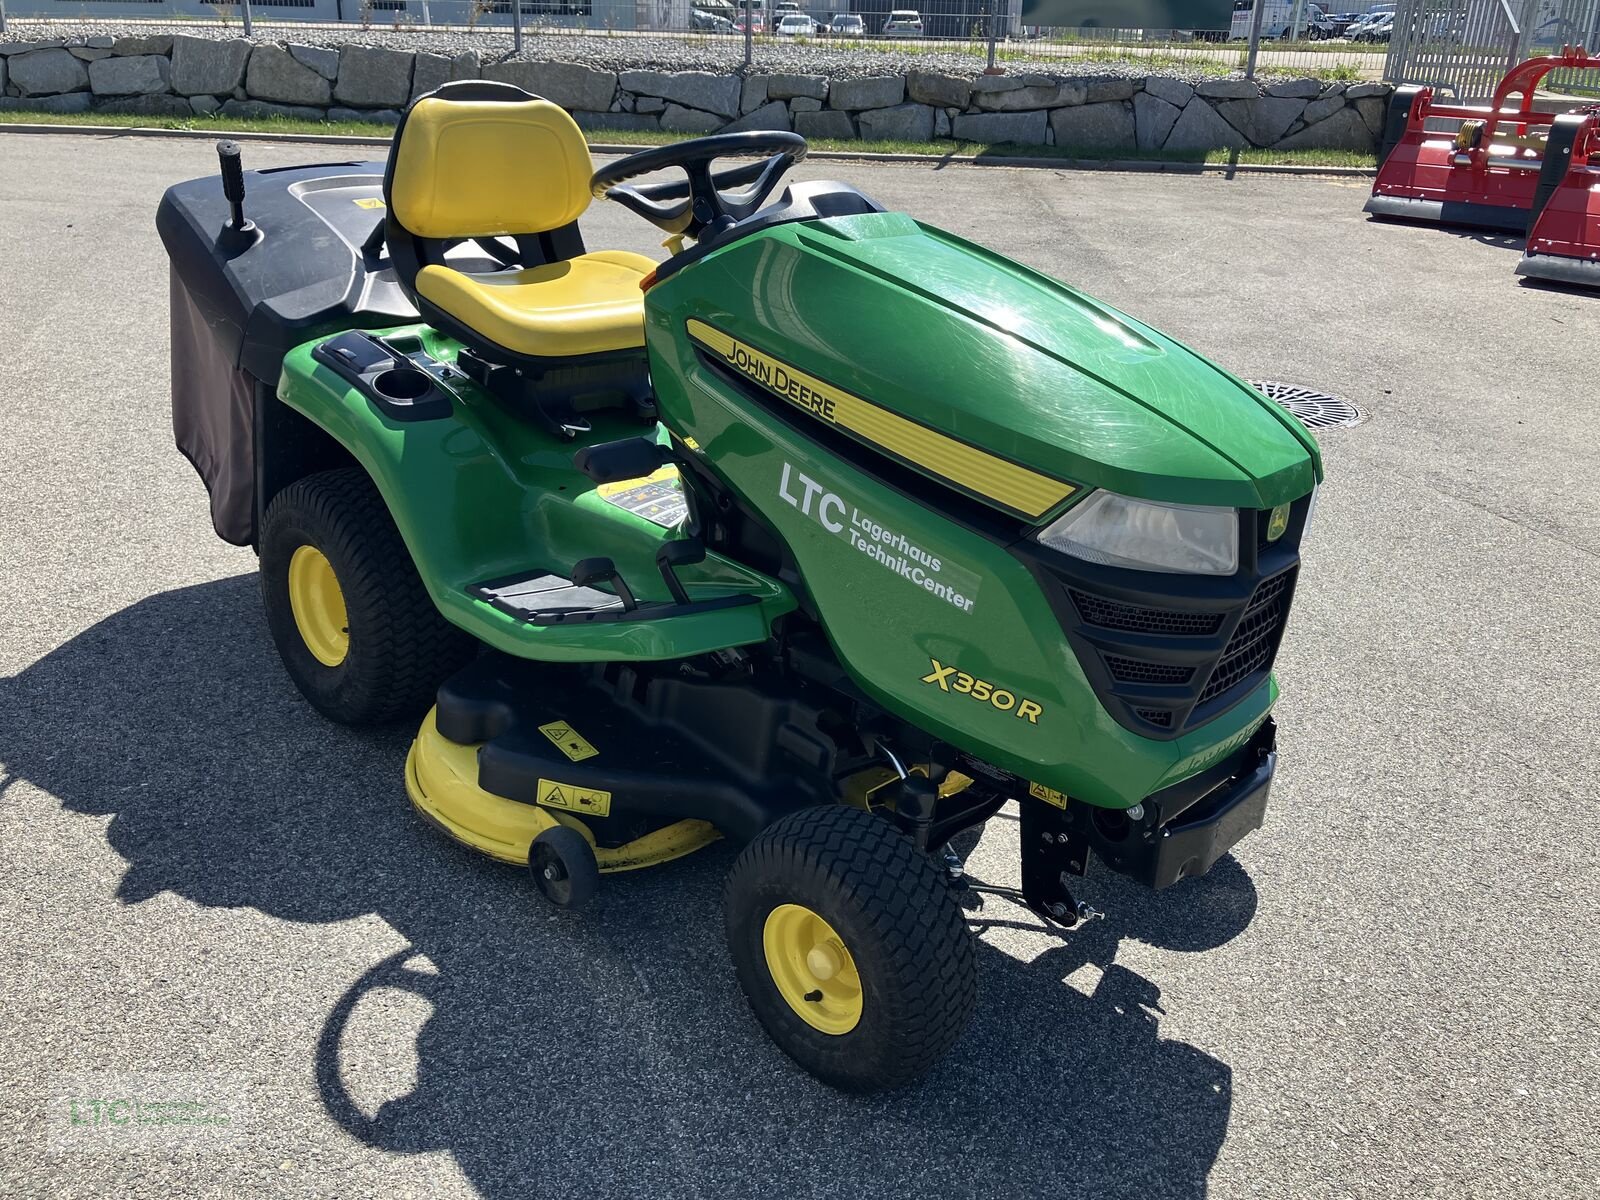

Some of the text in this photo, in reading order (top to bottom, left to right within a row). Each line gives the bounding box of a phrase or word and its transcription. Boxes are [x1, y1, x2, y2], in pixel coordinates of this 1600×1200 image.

[726, 341, 836, 421] JOHN DEERE
[779, 462, 846, 533] LTC
[849, 527, 974, 611] TechnikCenter
[851, 508, 942, 572] Lagerhaus
